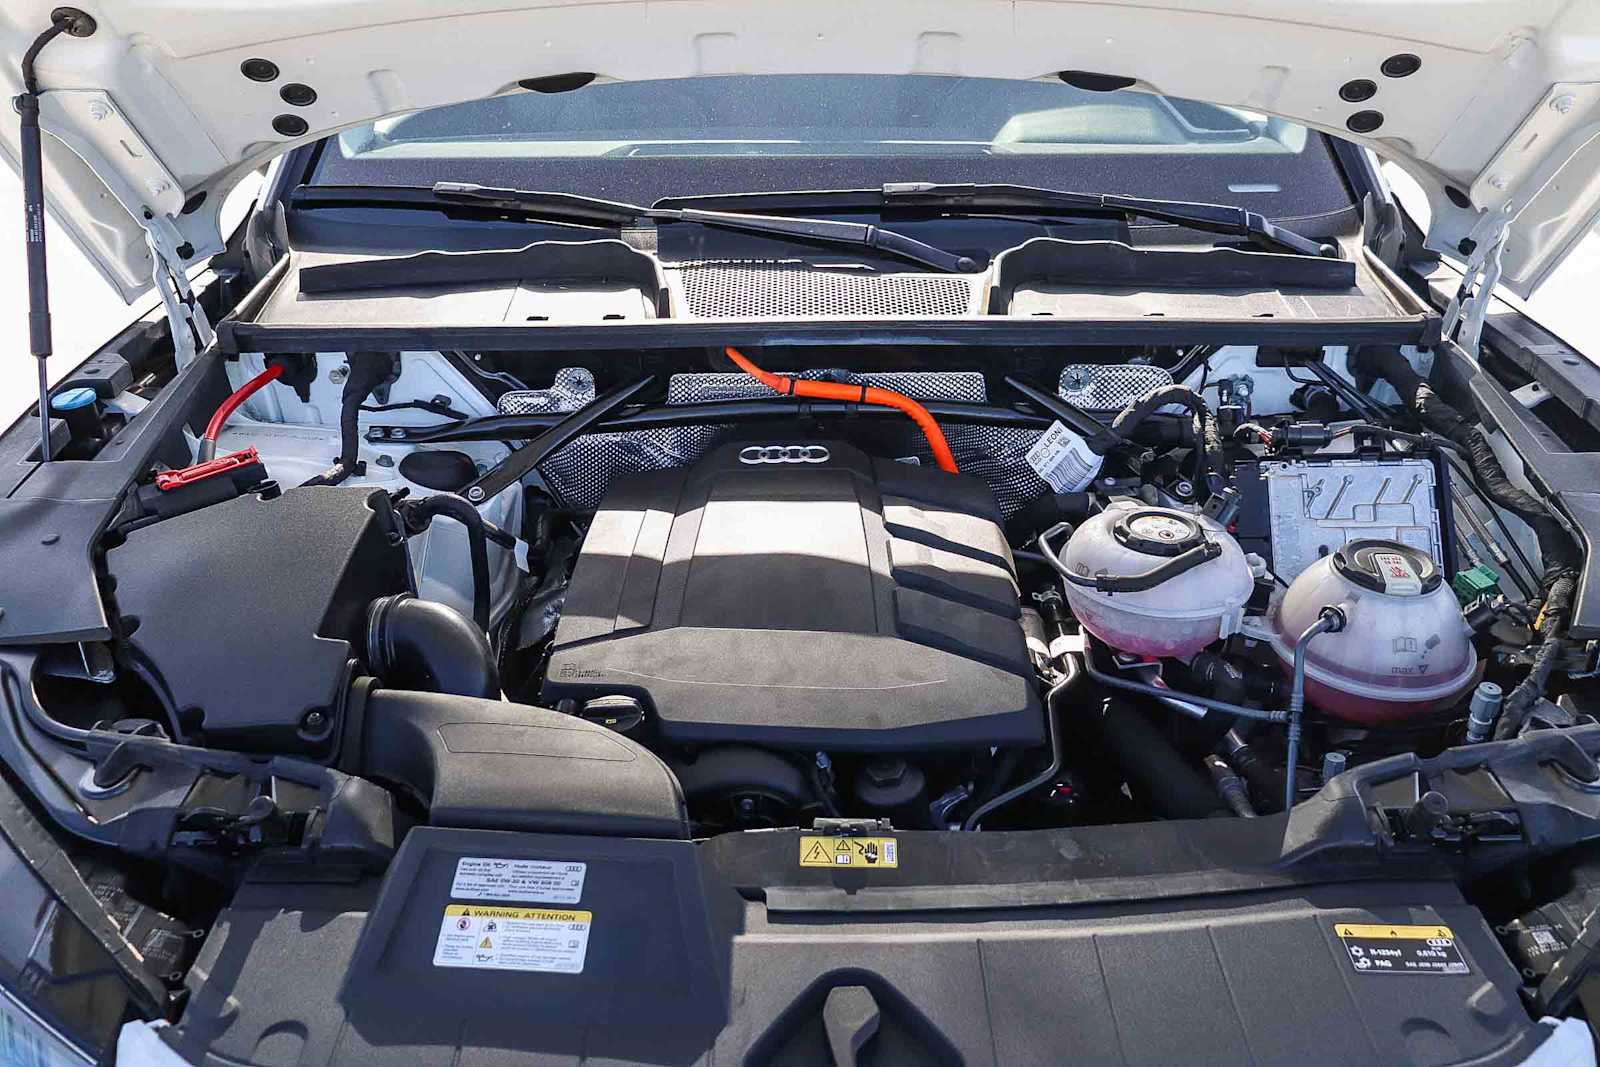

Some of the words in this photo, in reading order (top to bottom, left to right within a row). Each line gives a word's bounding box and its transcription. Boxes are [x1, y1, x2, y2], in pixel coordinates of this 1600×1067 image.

[1043, 426, 1064, 448] LEONI
[473, 909, 519, 919] WARNING
[523, 911, 576, 921] ATTENTION
